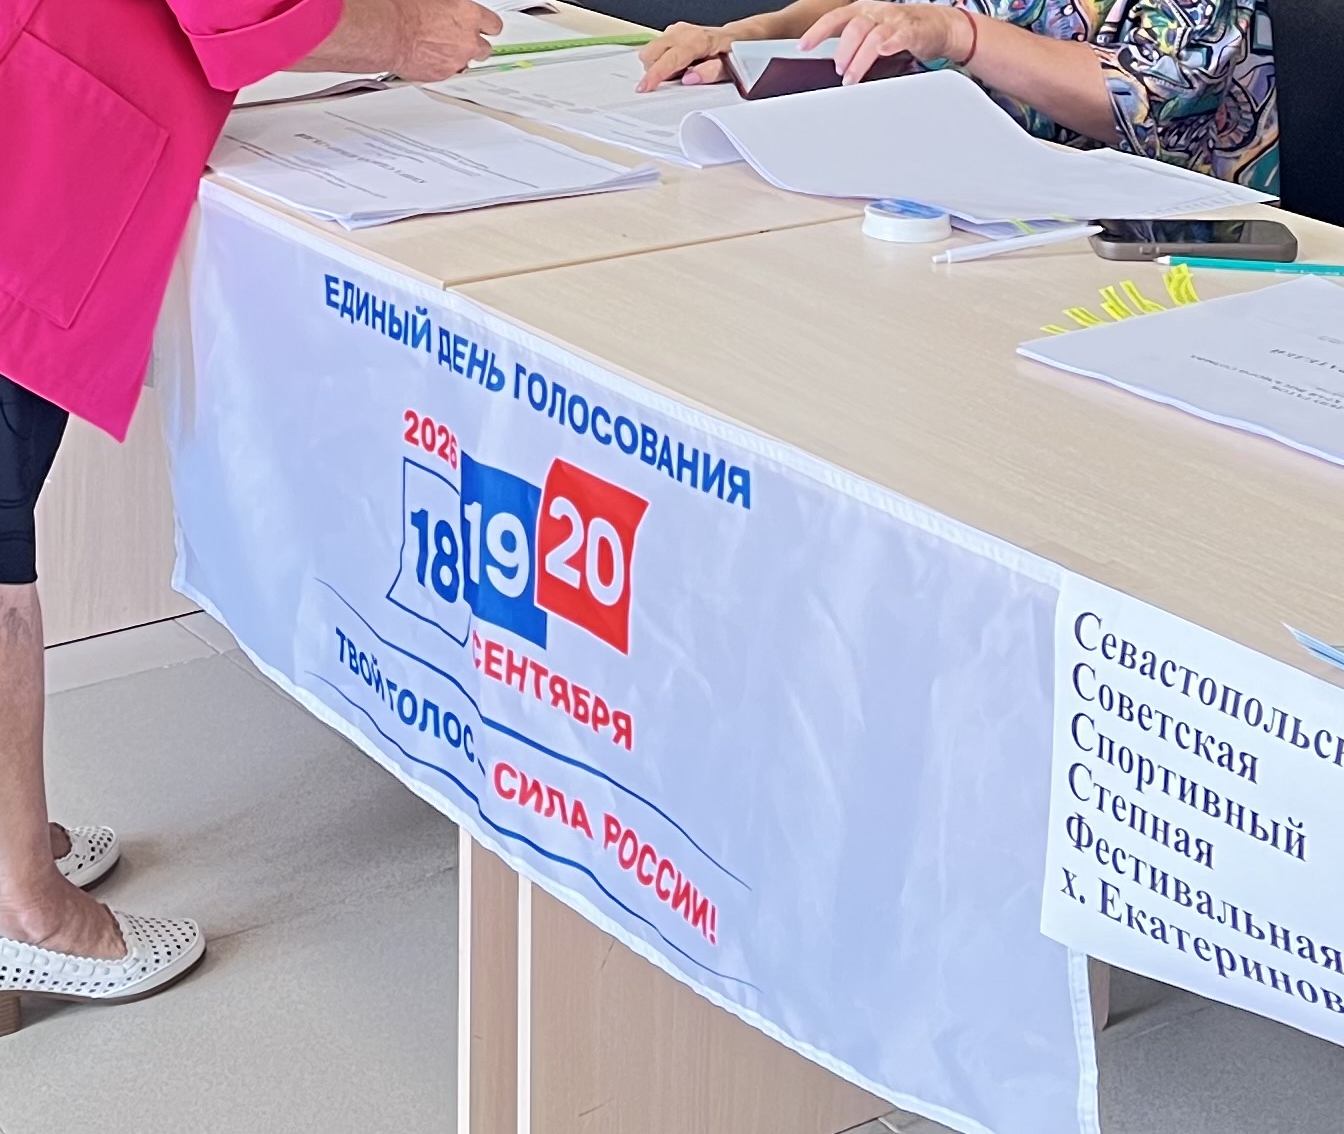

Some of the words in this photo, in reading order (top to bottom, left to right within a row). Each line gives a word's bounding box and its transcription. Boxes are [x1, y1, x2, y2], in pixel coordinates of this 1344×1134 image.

[324, 273, 432, 354] ЕДИНЫЙ
[438, 325, 506, 393] ДЕНЬ
[513, 362, 751, 510] ГОЛОСОВАНИЯ
[403, 409, 458, 470] 2026
[411, 508, 460, 603] 18
[464, 501, 530, 598] 19
[545, 496, 625, 606] 20
[472, 629, 634, 752] СЕНТЯБРЯ
[1072, 662, 1259, 785] Советская
[336, 626, 385, 702] ТВОЙ
[385, 677, 475, 764] ГОЛОС
[494, 762, 594, 841] СИЛА
[603, 812, 717, 946] РОССИИ!
[1068, 762, 1214, 870] Степная
[1071, 712, 1308, 862] Спортивный
[1060, 866, 1087, 905] х.
